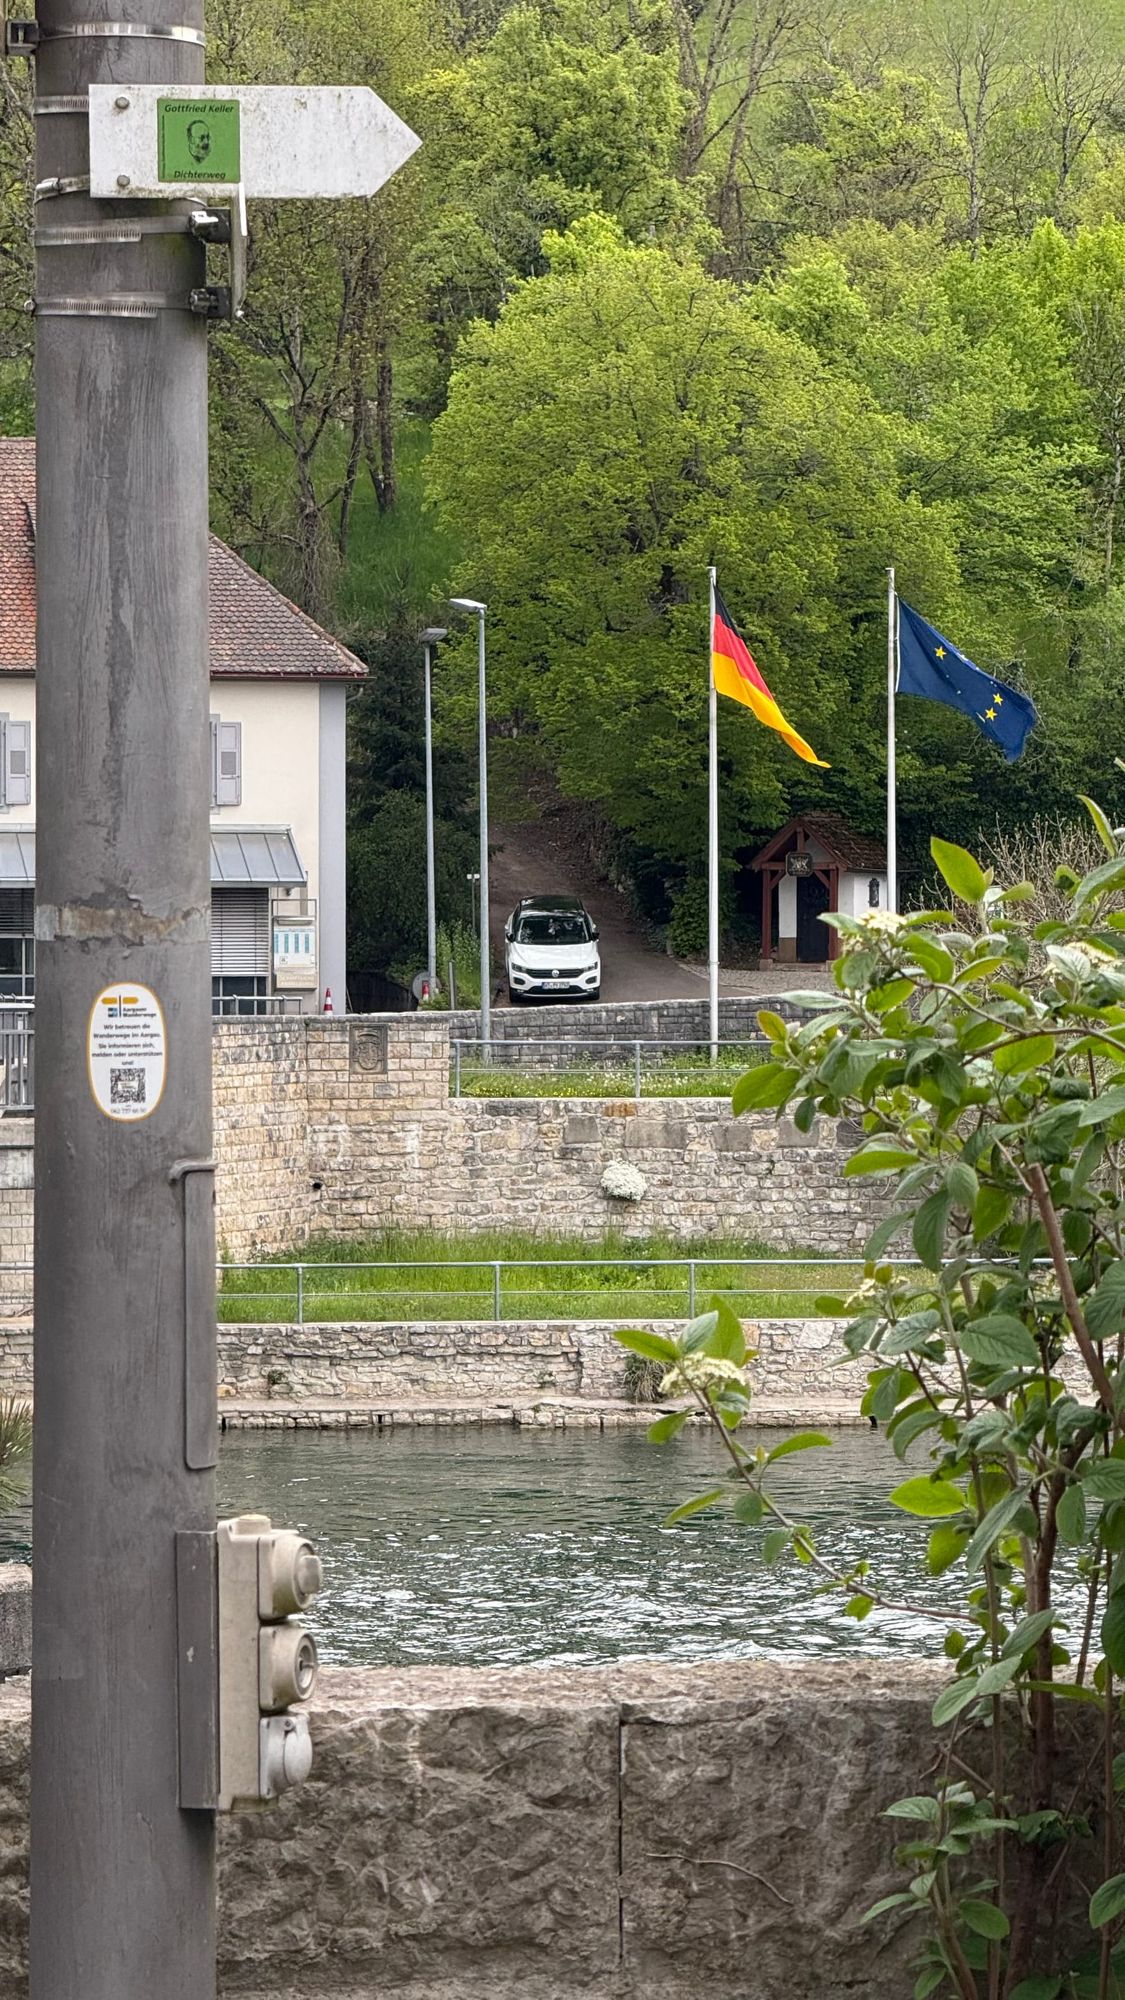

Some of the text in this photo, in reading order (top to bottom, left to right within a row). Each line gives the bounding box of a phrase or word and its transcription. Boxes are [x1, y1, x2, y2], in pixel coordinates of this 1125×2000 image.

[164, 104, 234, 113] Gottfried Keller
[174, 170, 226, 180] Dichterweg
